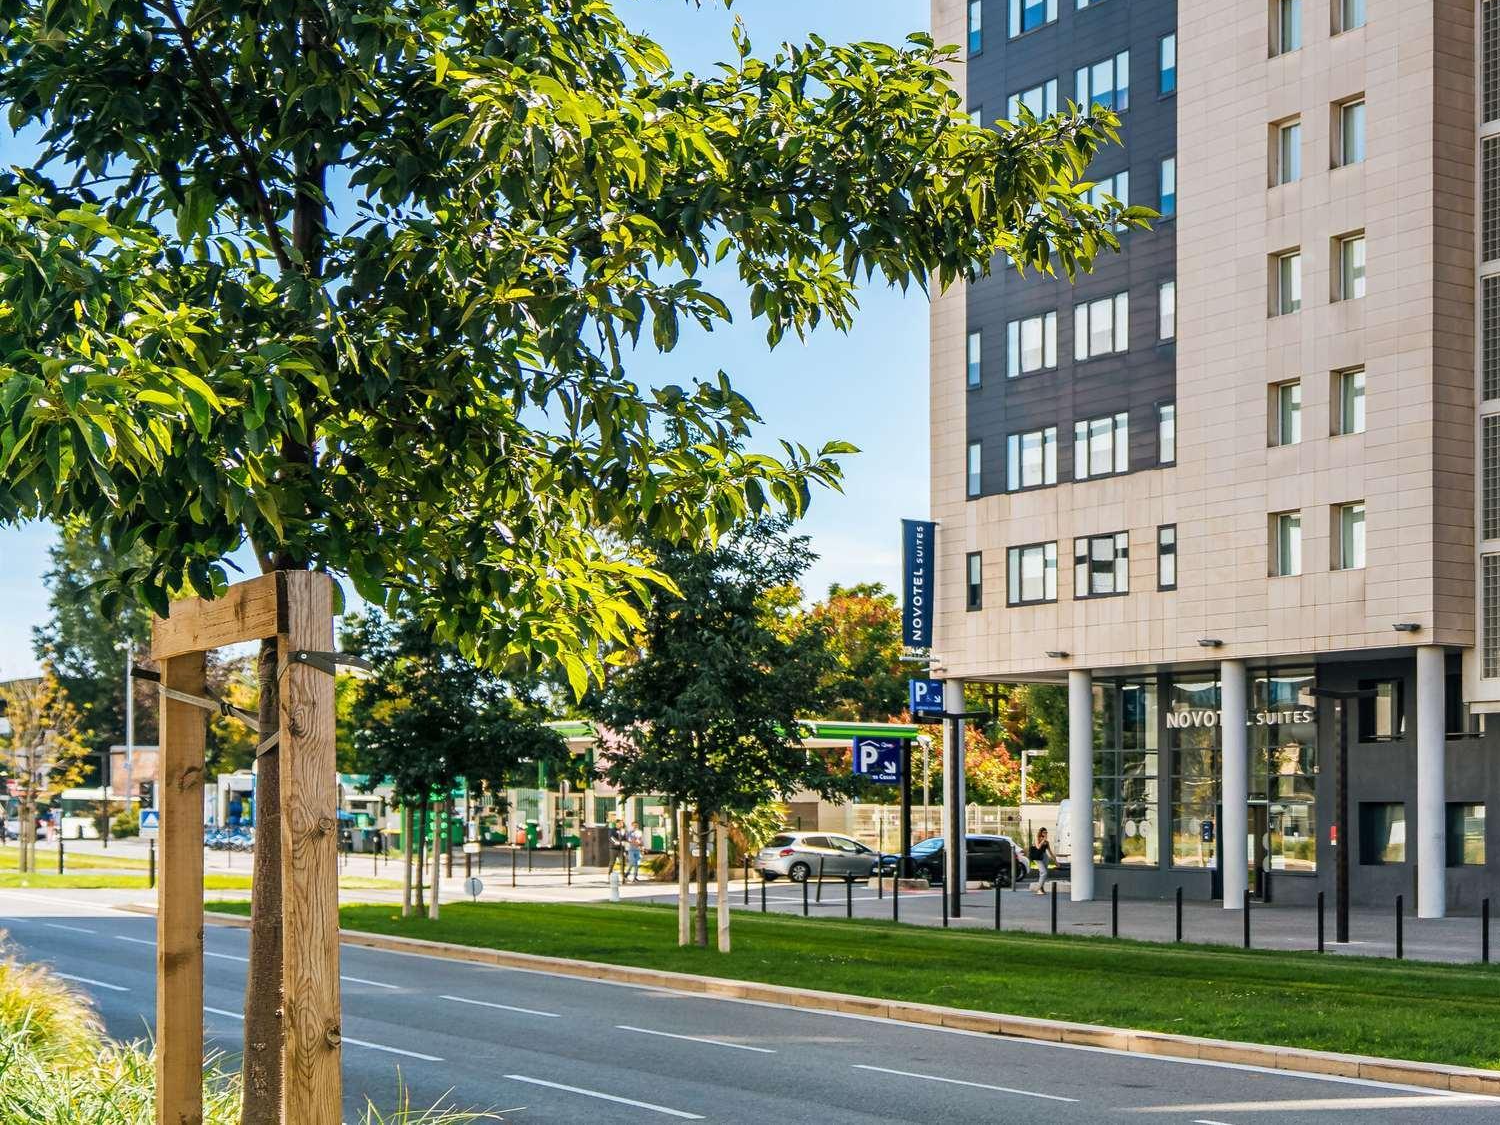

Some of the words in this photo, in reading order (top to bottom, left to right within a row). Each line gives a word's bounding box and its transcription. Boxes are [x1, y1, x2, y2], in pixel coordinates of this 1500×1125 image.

[916, 526, 924, 564] SUITES
[912, 568, 924, 641] NOVOTEL
[915, 681, 928, 703] P
[1255, 710, 1312, 726] SUITES
[860, 745, 879, 773] P
